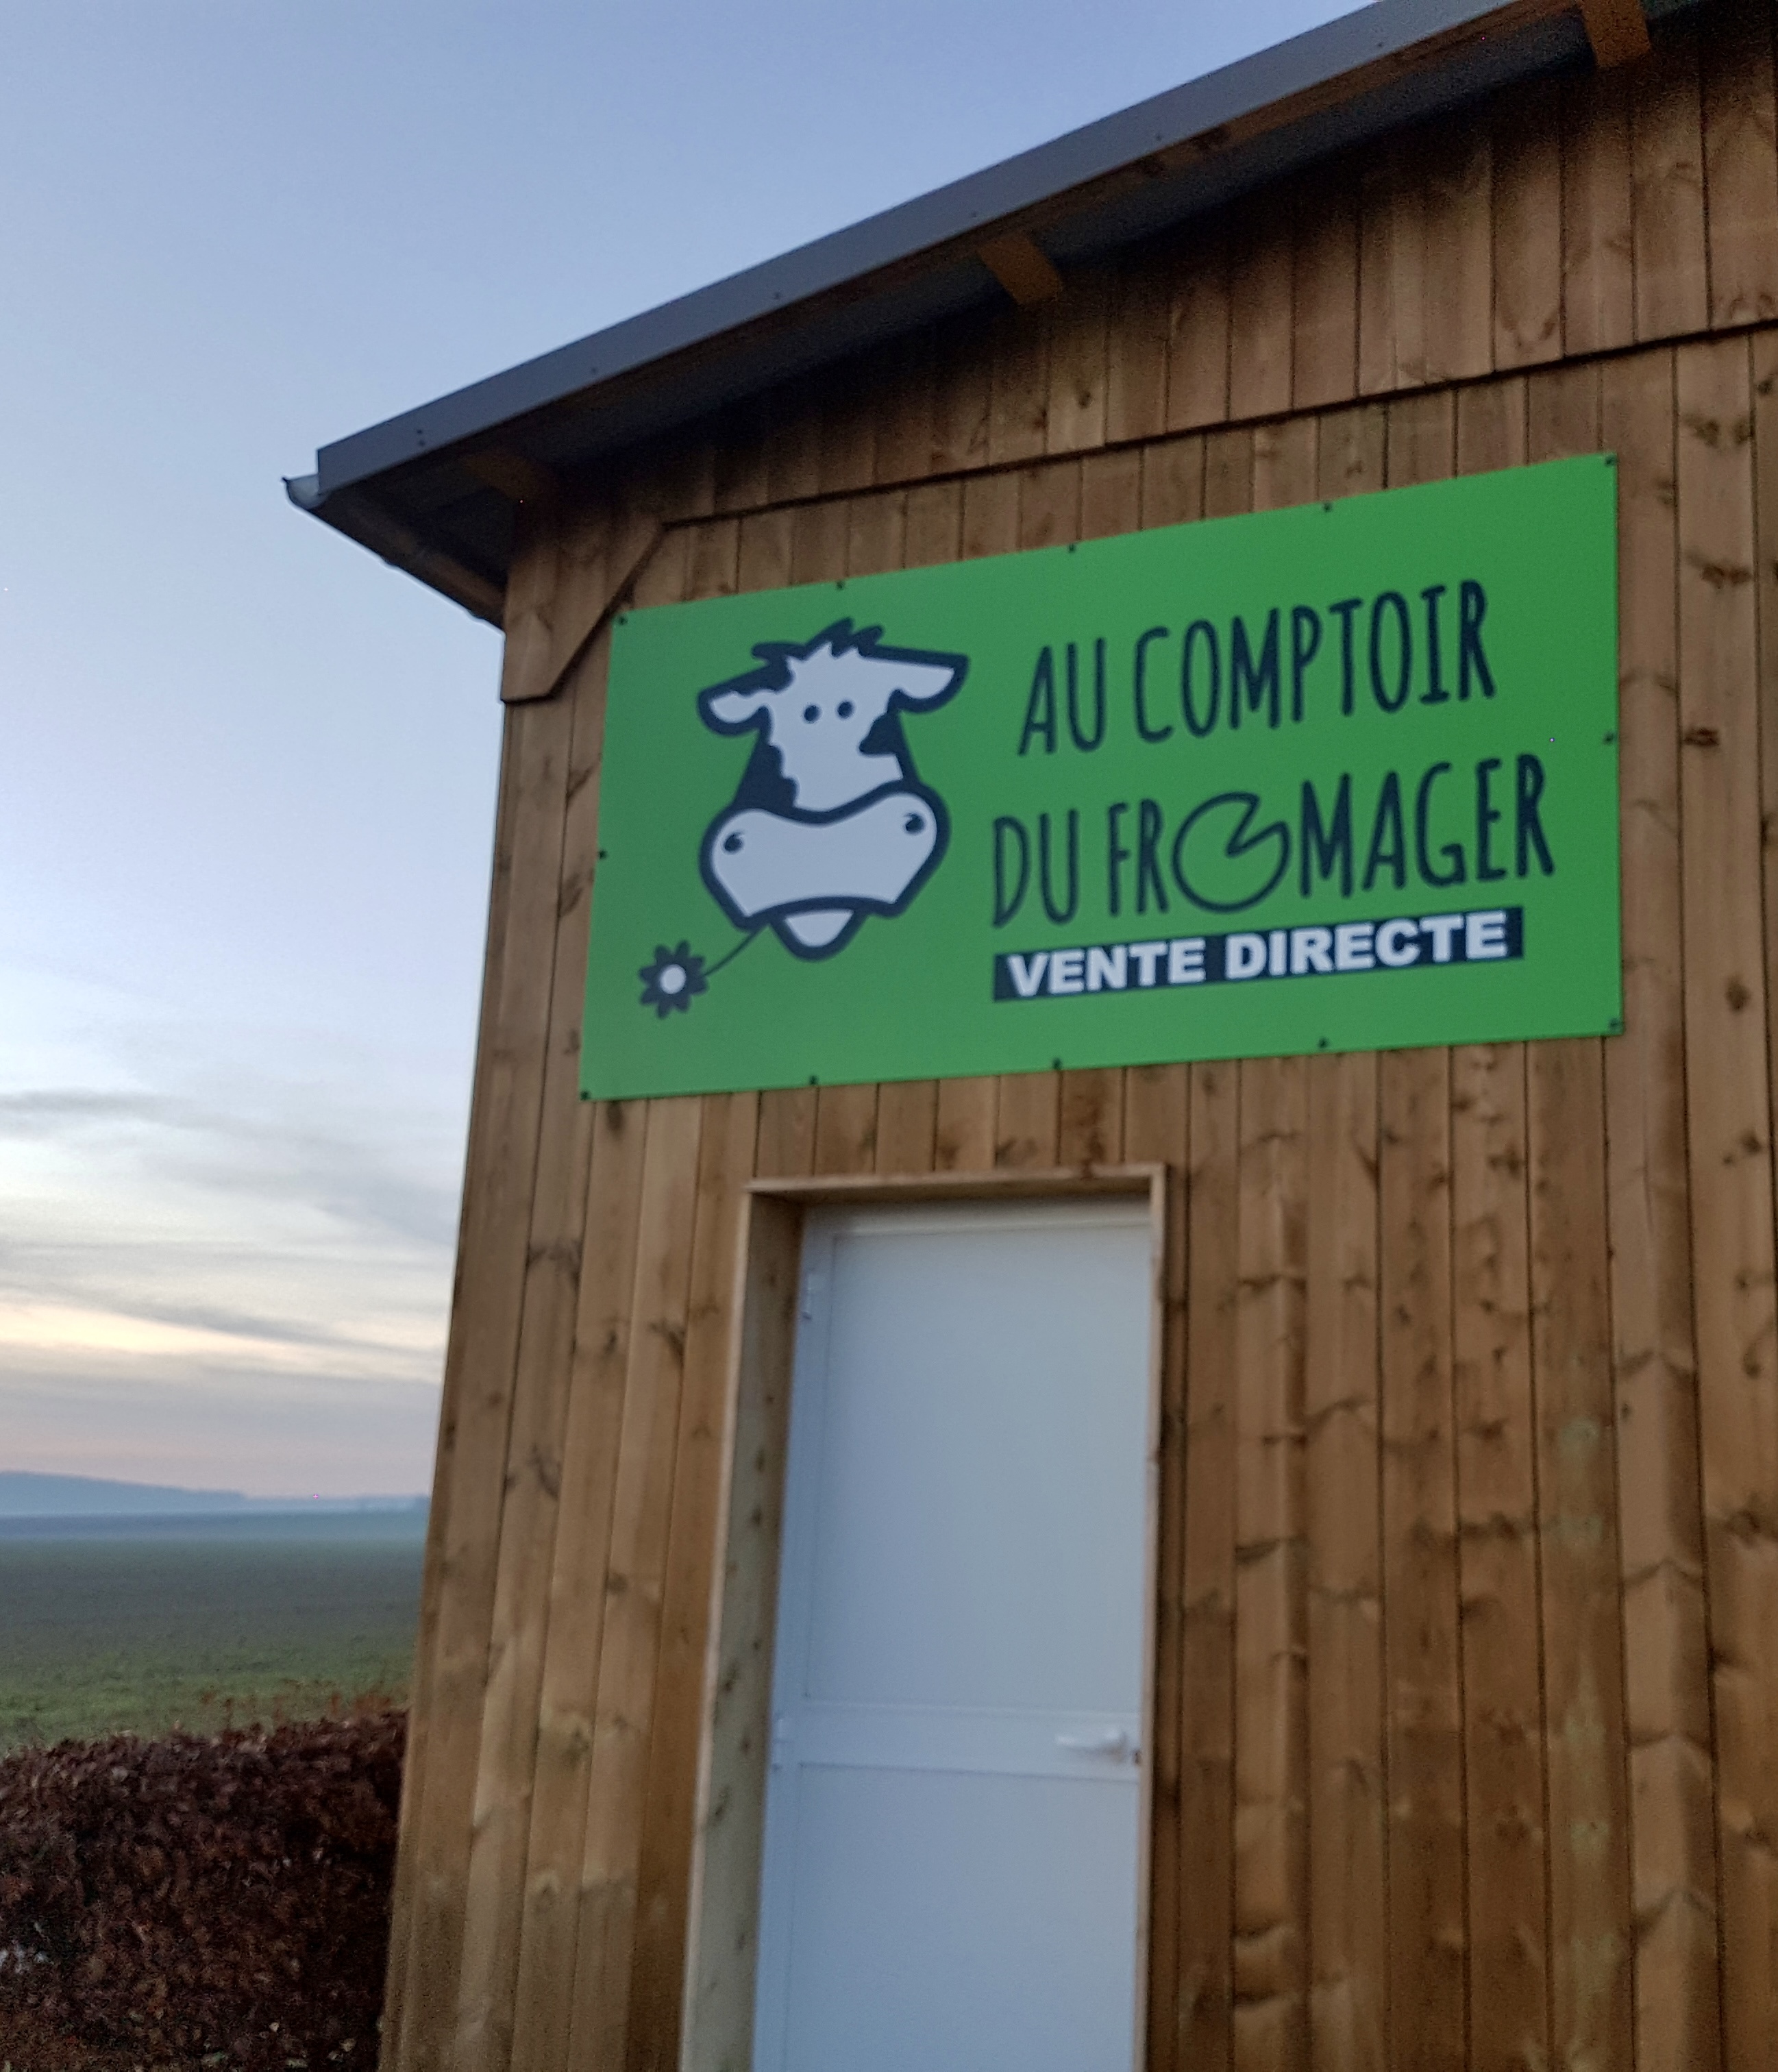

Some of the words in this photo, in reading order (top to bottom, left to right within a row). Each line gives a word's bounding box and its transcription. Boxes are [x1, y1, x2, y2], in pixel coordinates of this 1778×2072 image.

[1018, 637, 1106, 756] AU
[1134, 579, 1496, 743] COMPTOIR
[992, 809, 1078, 928] DU
[1107, 753, 1555, 916] FROMAGER
[1007, 939, 1206, 998] VENTE
[1224, 910, 1507, 980] DIRECTE
